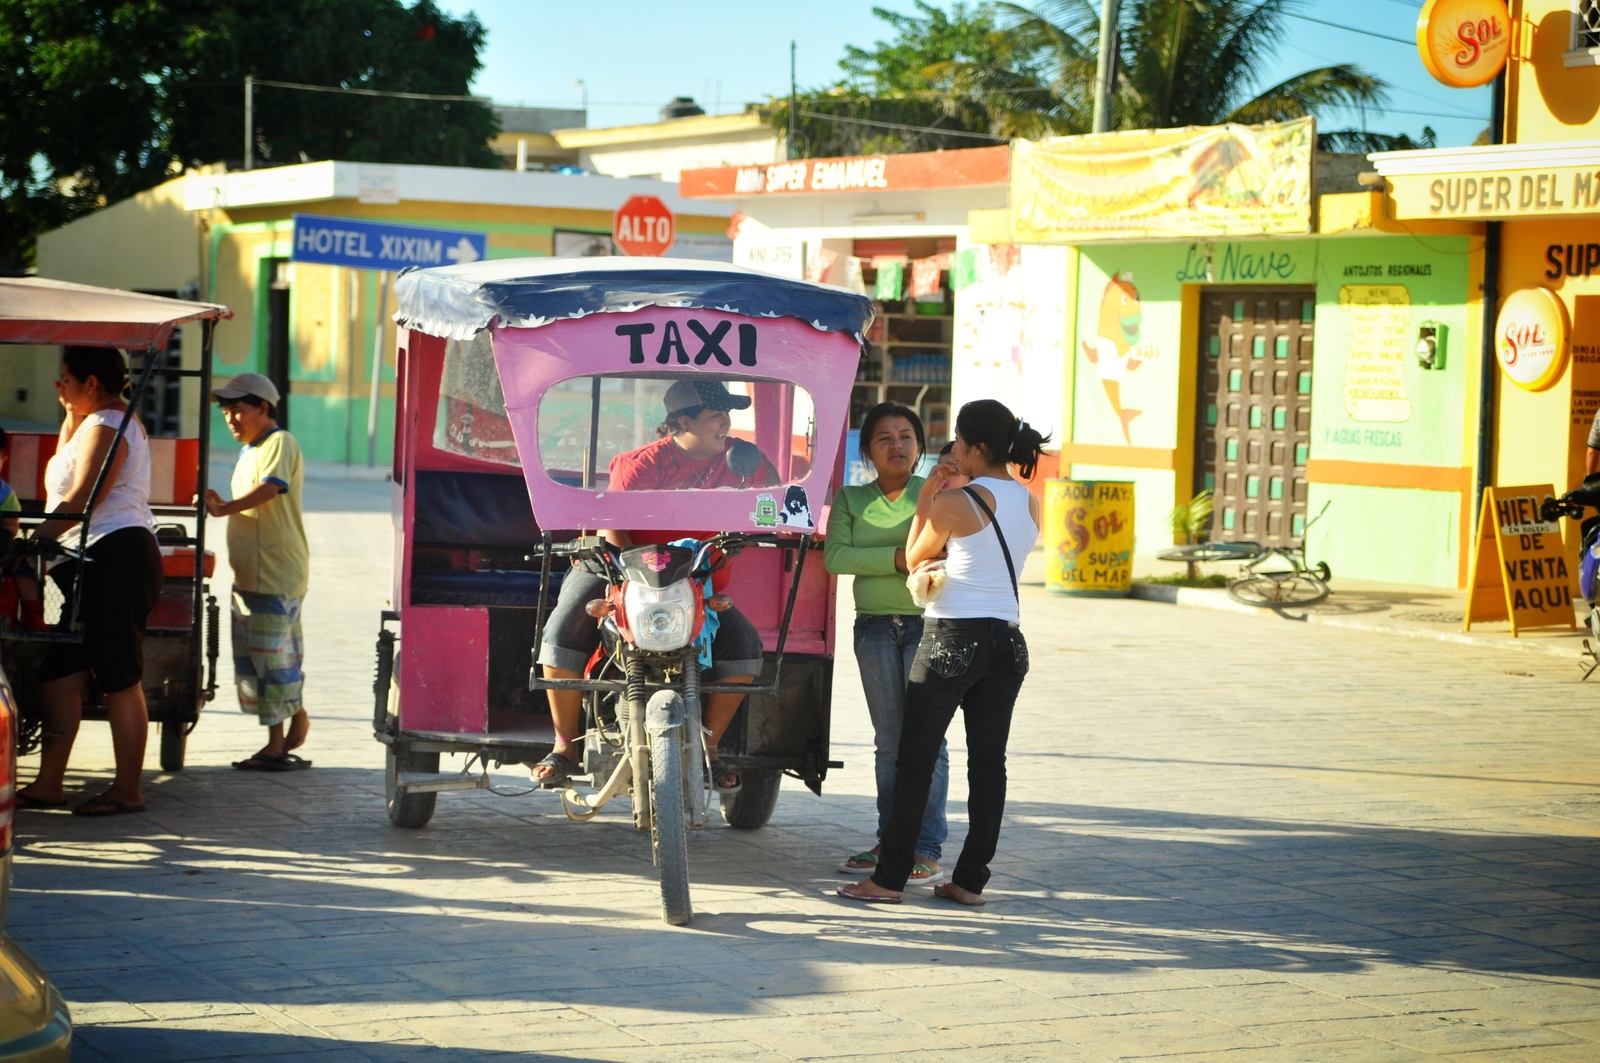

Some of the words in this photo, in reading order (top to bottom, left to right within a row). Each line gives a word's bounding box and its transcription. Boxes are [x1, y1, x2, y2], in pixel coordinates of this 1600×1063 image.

[766, 162, 807, 192] SUPER
[811, 158, 888, 190] EMANUEL
[1430, 176, 1512, 213] SUPER
[1518, 173, 1564, 211] DEL
[618, 215, 671, 243] ALTO
[298, 227, 373, 258] HOTEL
[379, 234, 443, 264] XIXIM
[1220, 242, 1297, 282] Nave
[1343, 264, 1383, 277] ANTOJITOS
[1388, 263, 1433, 277] REGIONALES
[615, 319, 758, 367] TAXI
[1364, 430, 1402, 448] FRESCAS
[1520, 533, 1544, 551] DE
[1094, 569, 1129, 584] MAR
[1505, 557, 1569, 582] VENTA
[1513, 585, 1571, 613] AQUI
